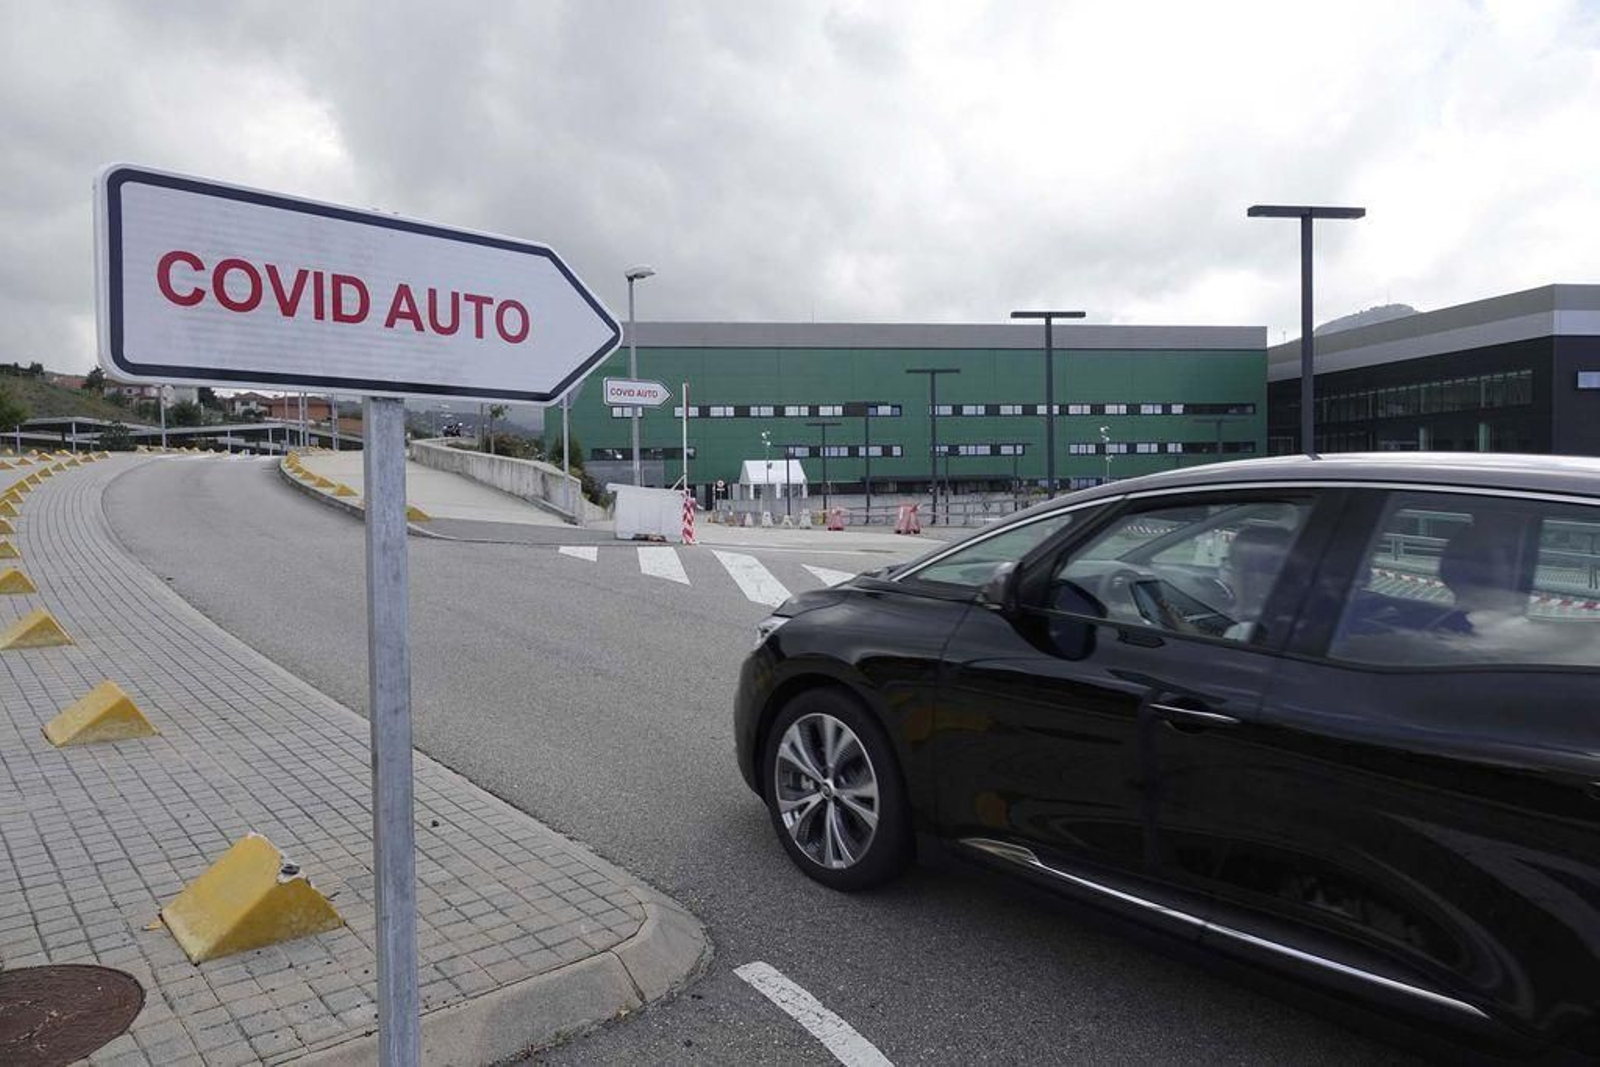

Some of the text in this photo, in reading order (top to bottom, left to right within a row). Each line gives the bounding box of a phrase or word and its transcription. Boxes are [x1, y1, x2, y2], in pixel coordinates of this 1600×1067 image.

[157, 250, 530, 343] COVID AUTO
[610, 387, 658, 398] COVID AUTO
